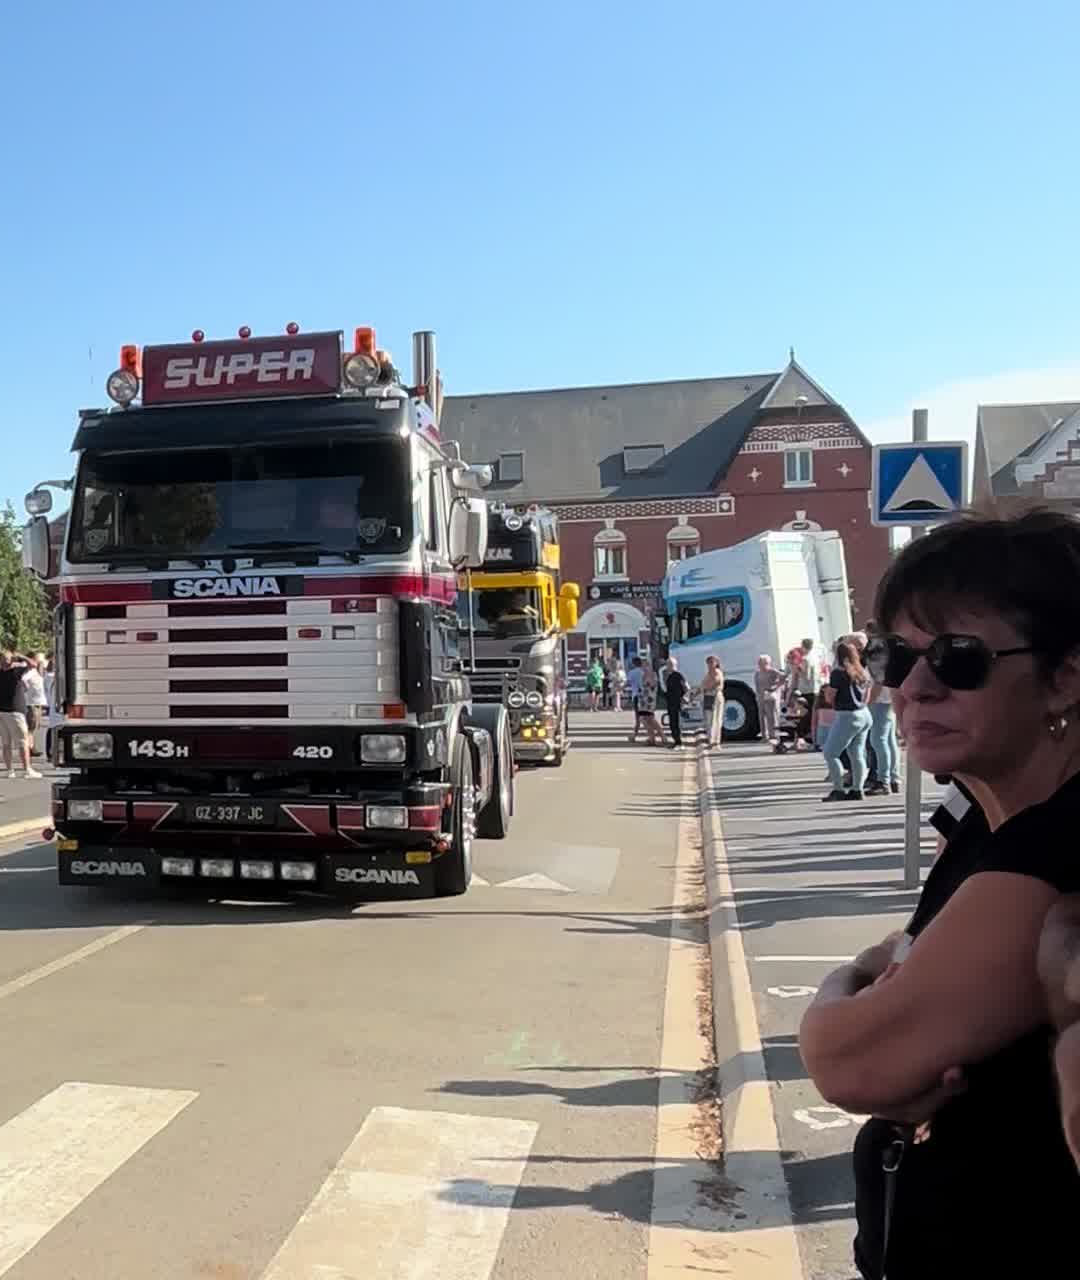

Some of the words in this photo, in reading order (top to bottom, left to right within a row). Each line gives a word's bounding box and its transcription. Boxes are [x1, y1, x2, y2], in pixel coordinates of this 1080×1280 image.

[164, 348, 315, 389] SUPER
[173, 576, 281, 597] SCANIA
[292, 746, 333, 759] 420
[70, 861, 146, 876] SCANIA
[335, 867, 420, 885] SCANIA
